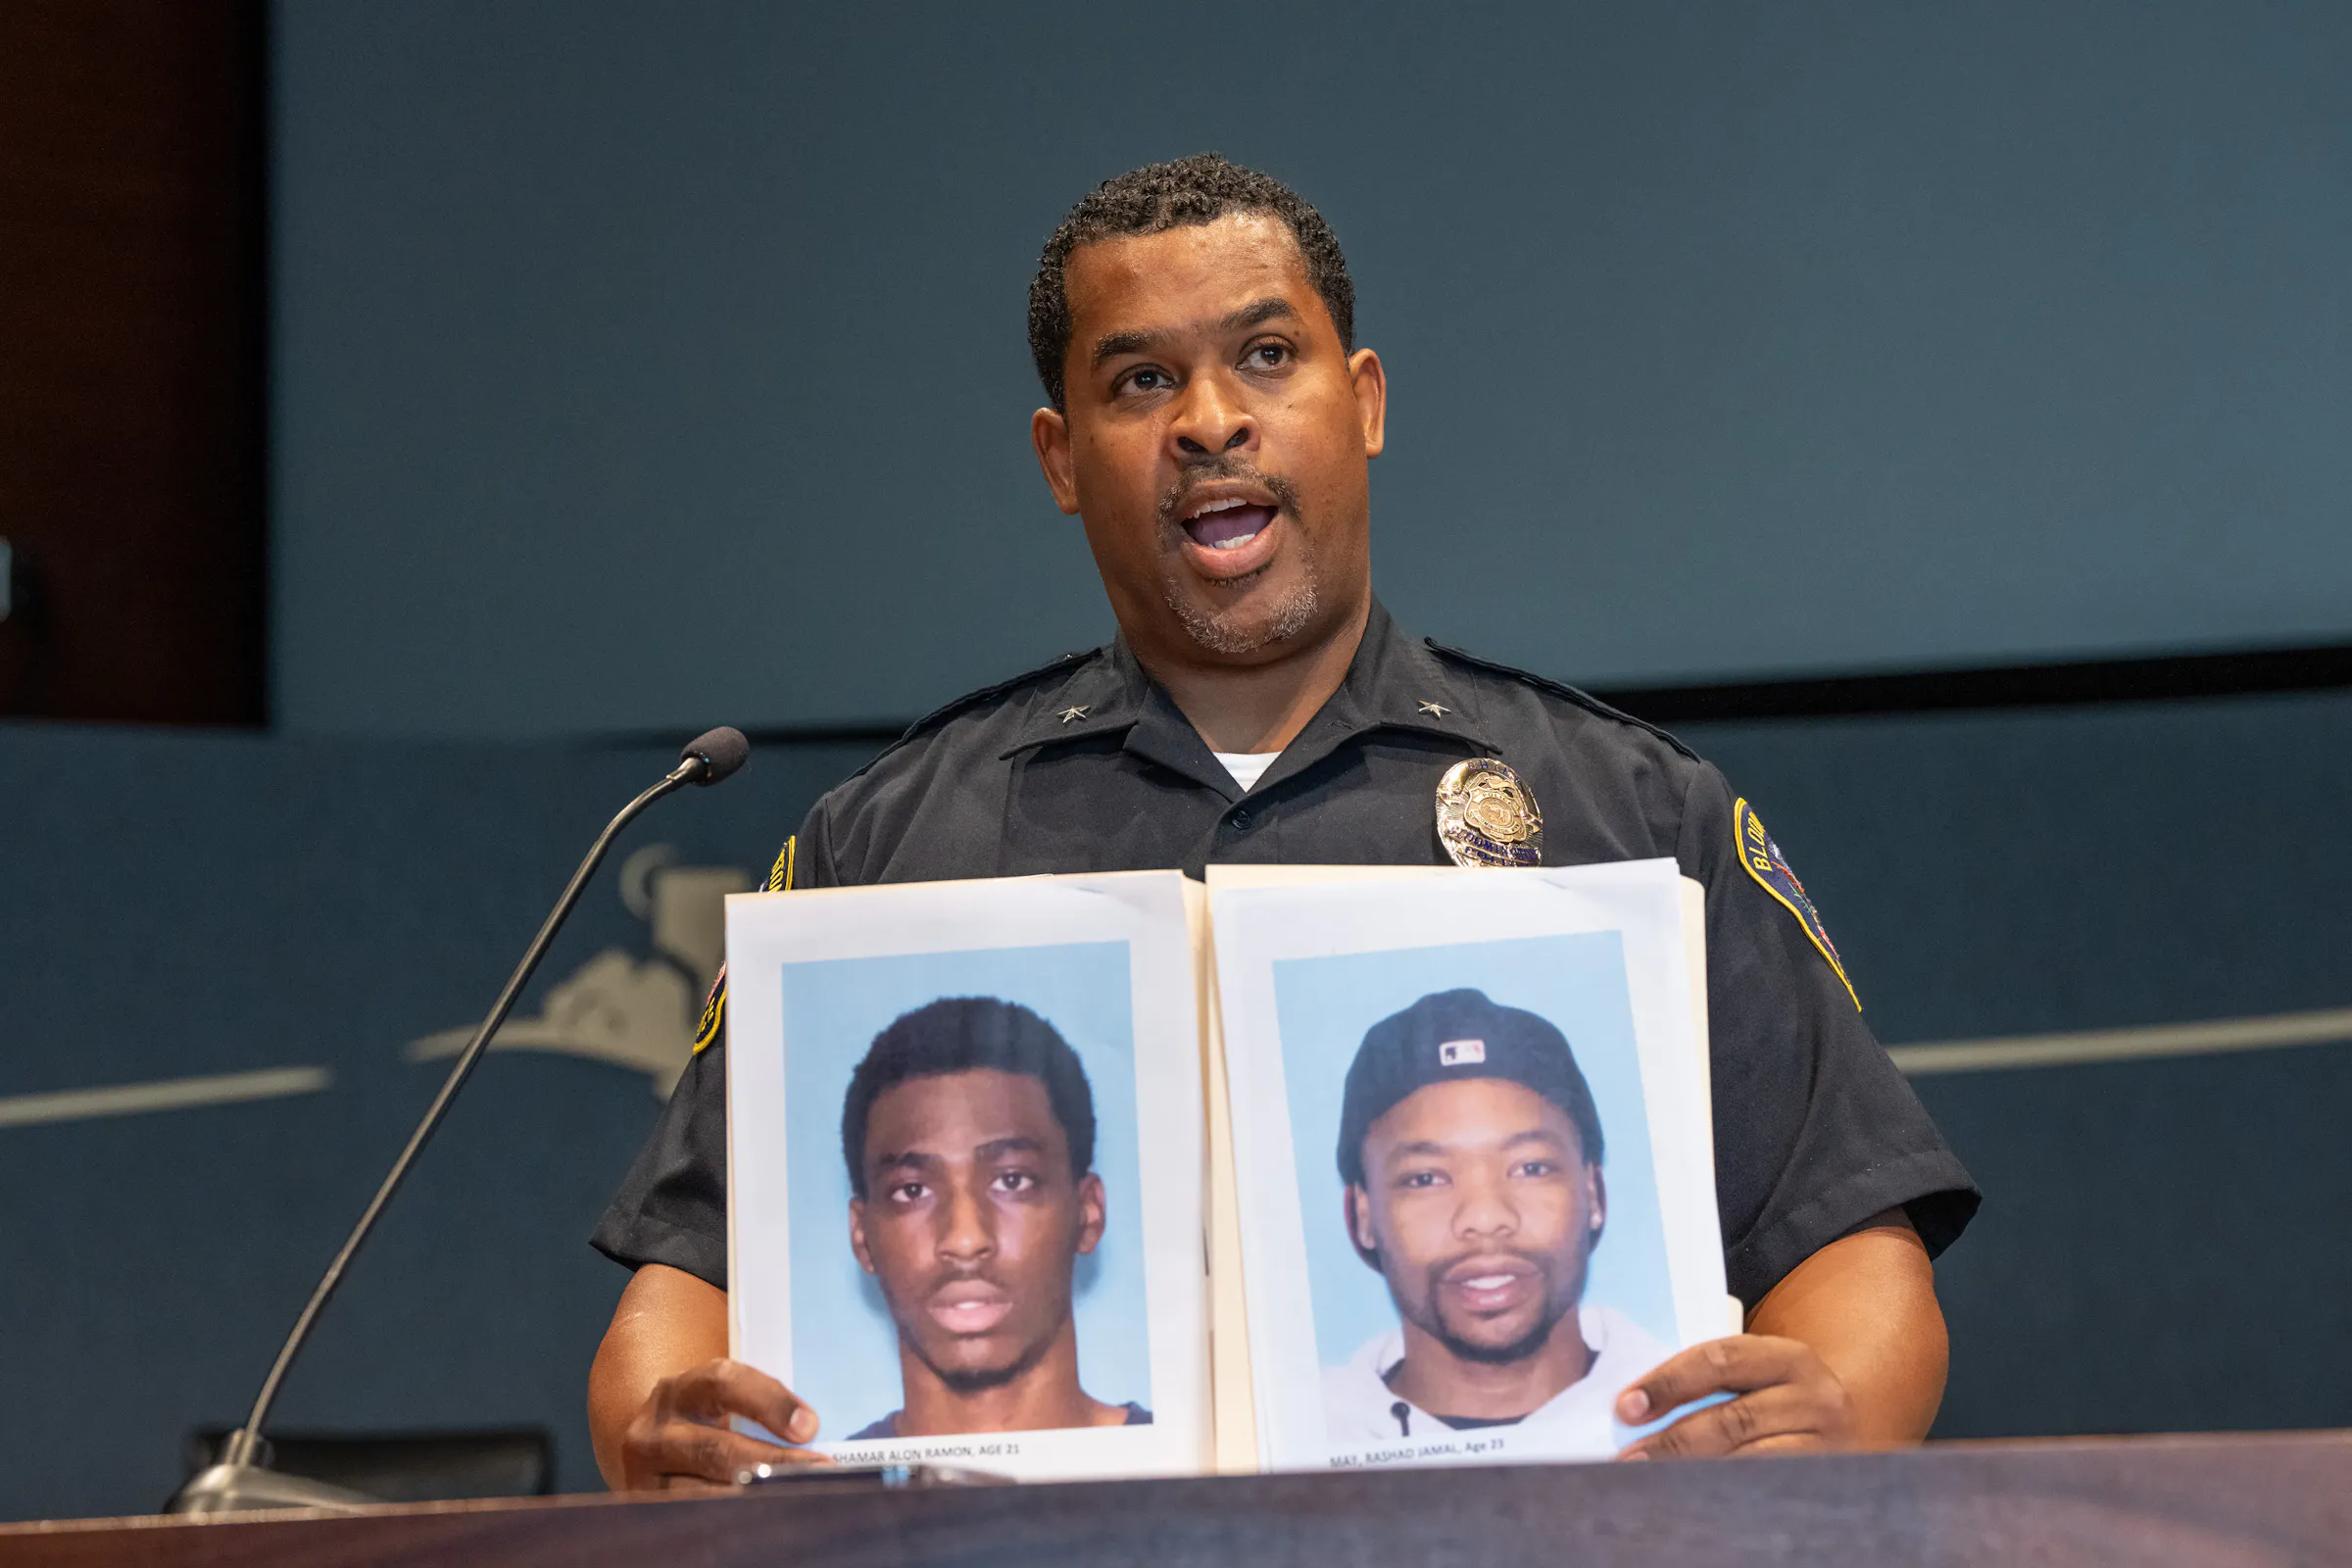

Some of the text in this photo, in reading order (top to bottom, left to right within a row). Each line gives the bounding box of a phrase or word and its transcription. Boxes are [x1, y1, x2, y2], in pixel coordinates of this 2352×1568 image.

[833, 1444, 1019, 1463] SHAMAR ALON RAMON, AGE 21
[1365, 1447, 1414, 1463] RASHAD
[1465, 1440, 1486, 1453] Age
